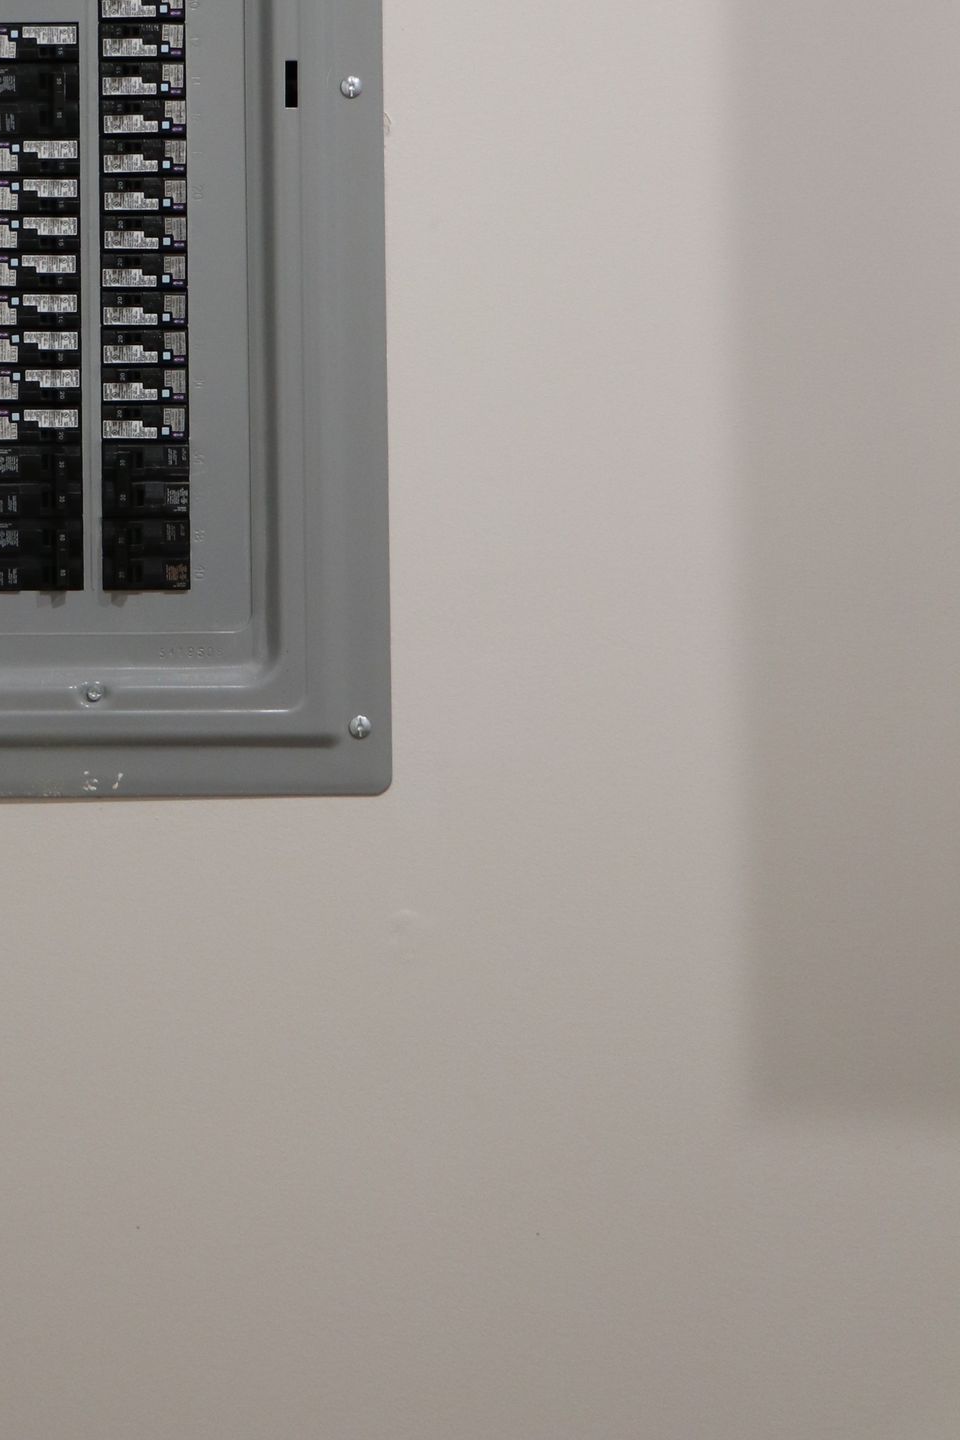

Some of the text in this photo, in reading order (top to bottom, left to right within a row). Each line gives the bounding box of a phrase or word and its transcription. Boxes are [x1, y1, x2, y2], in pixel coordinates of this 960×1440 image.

[118, 181, 123, 190] 20
[118, 219, 124, 229] 20
[117, 296, 122, 305] 20
[117, 334, 123, 343] 20
[119, 372, 125, 381] 20
[59, 391, 65, 400] 20
[117, 409, 122, 418] 20
